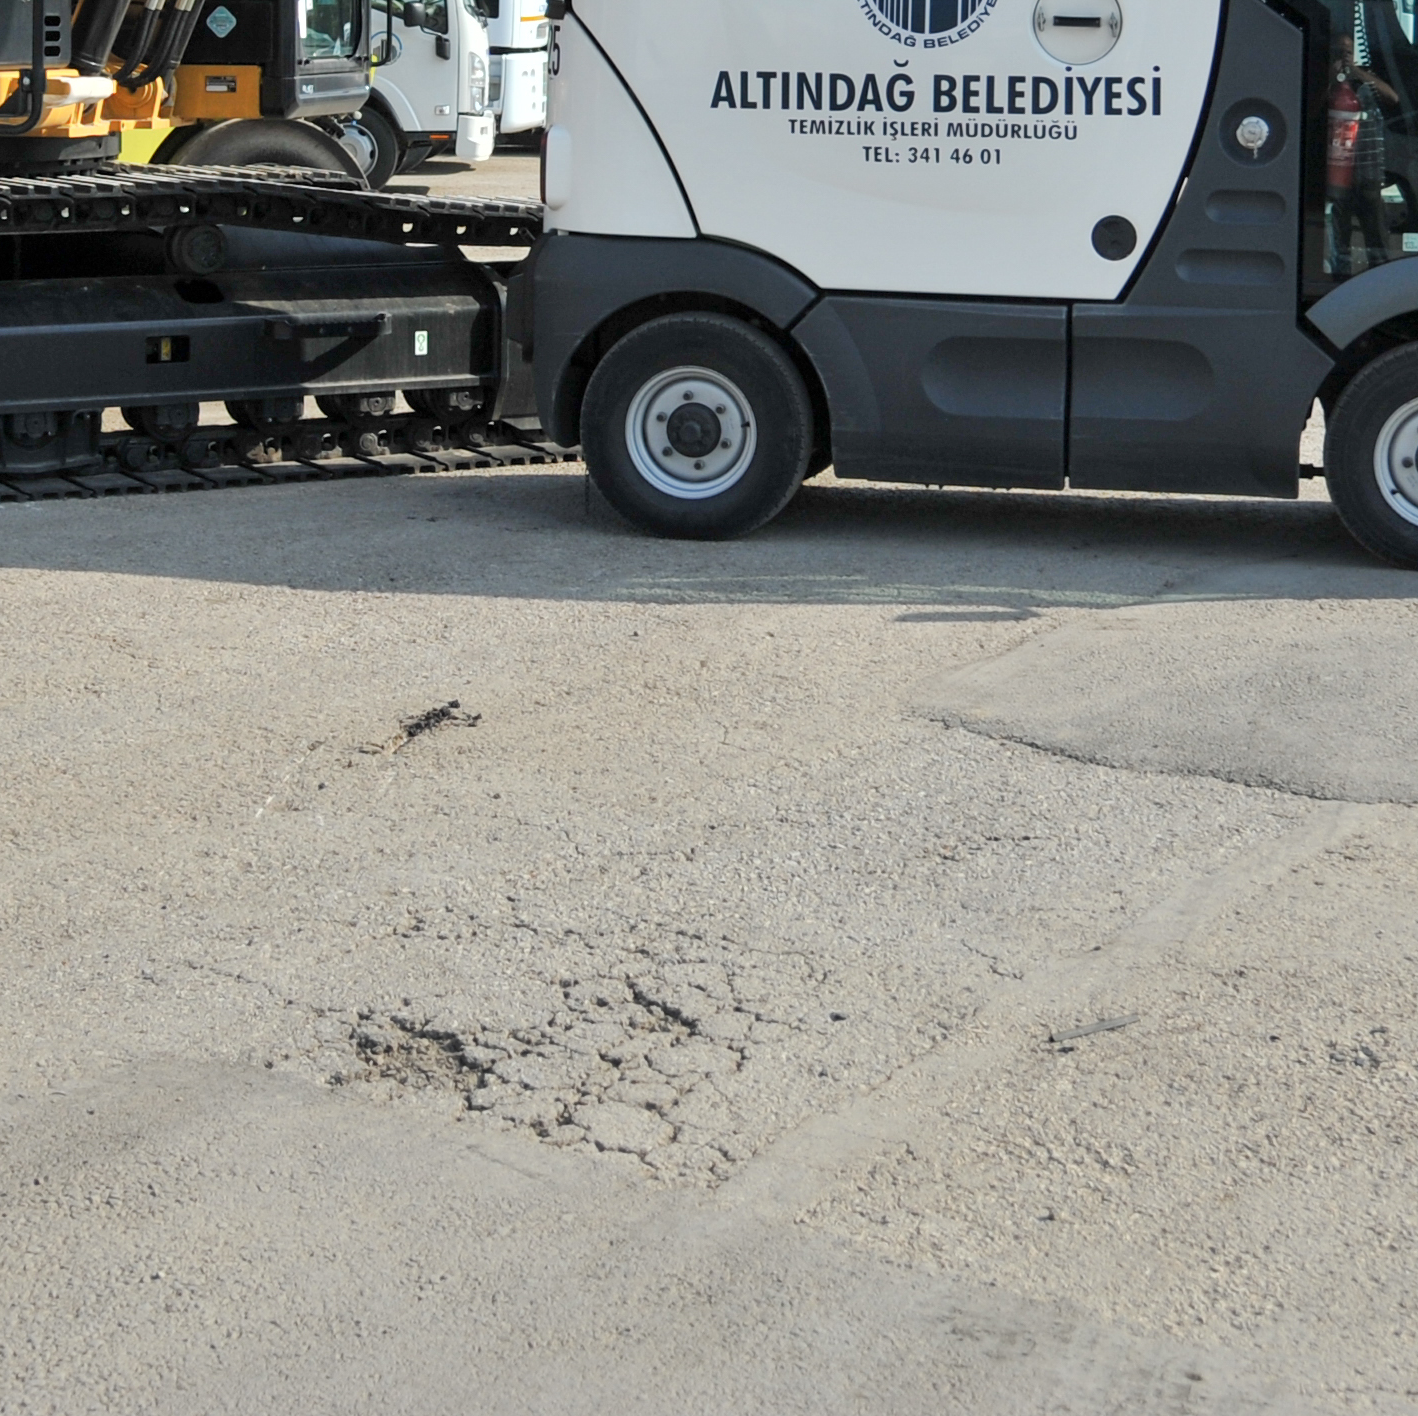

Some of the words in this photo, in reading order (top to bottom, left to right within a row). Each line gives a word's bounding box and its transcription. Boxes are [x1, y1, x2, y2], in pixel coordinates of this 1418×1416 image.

[709, 59, 916, 112] ALTINDAĞ
[931, 64, 1163, 117] BELEDİYESİ
[788, 118, 876, 137] TEMİZLİK
[882, 116, 940, 143] İŞLERİ
[946, 118, 1079, 141] MÜDÜRLÜĞÜ
[862, 146, 901, 164] TEL:
[906, 147, 942, 165] 341
[948, 147, 974, 165] 46
[978, 148, 1002, 165] 01
